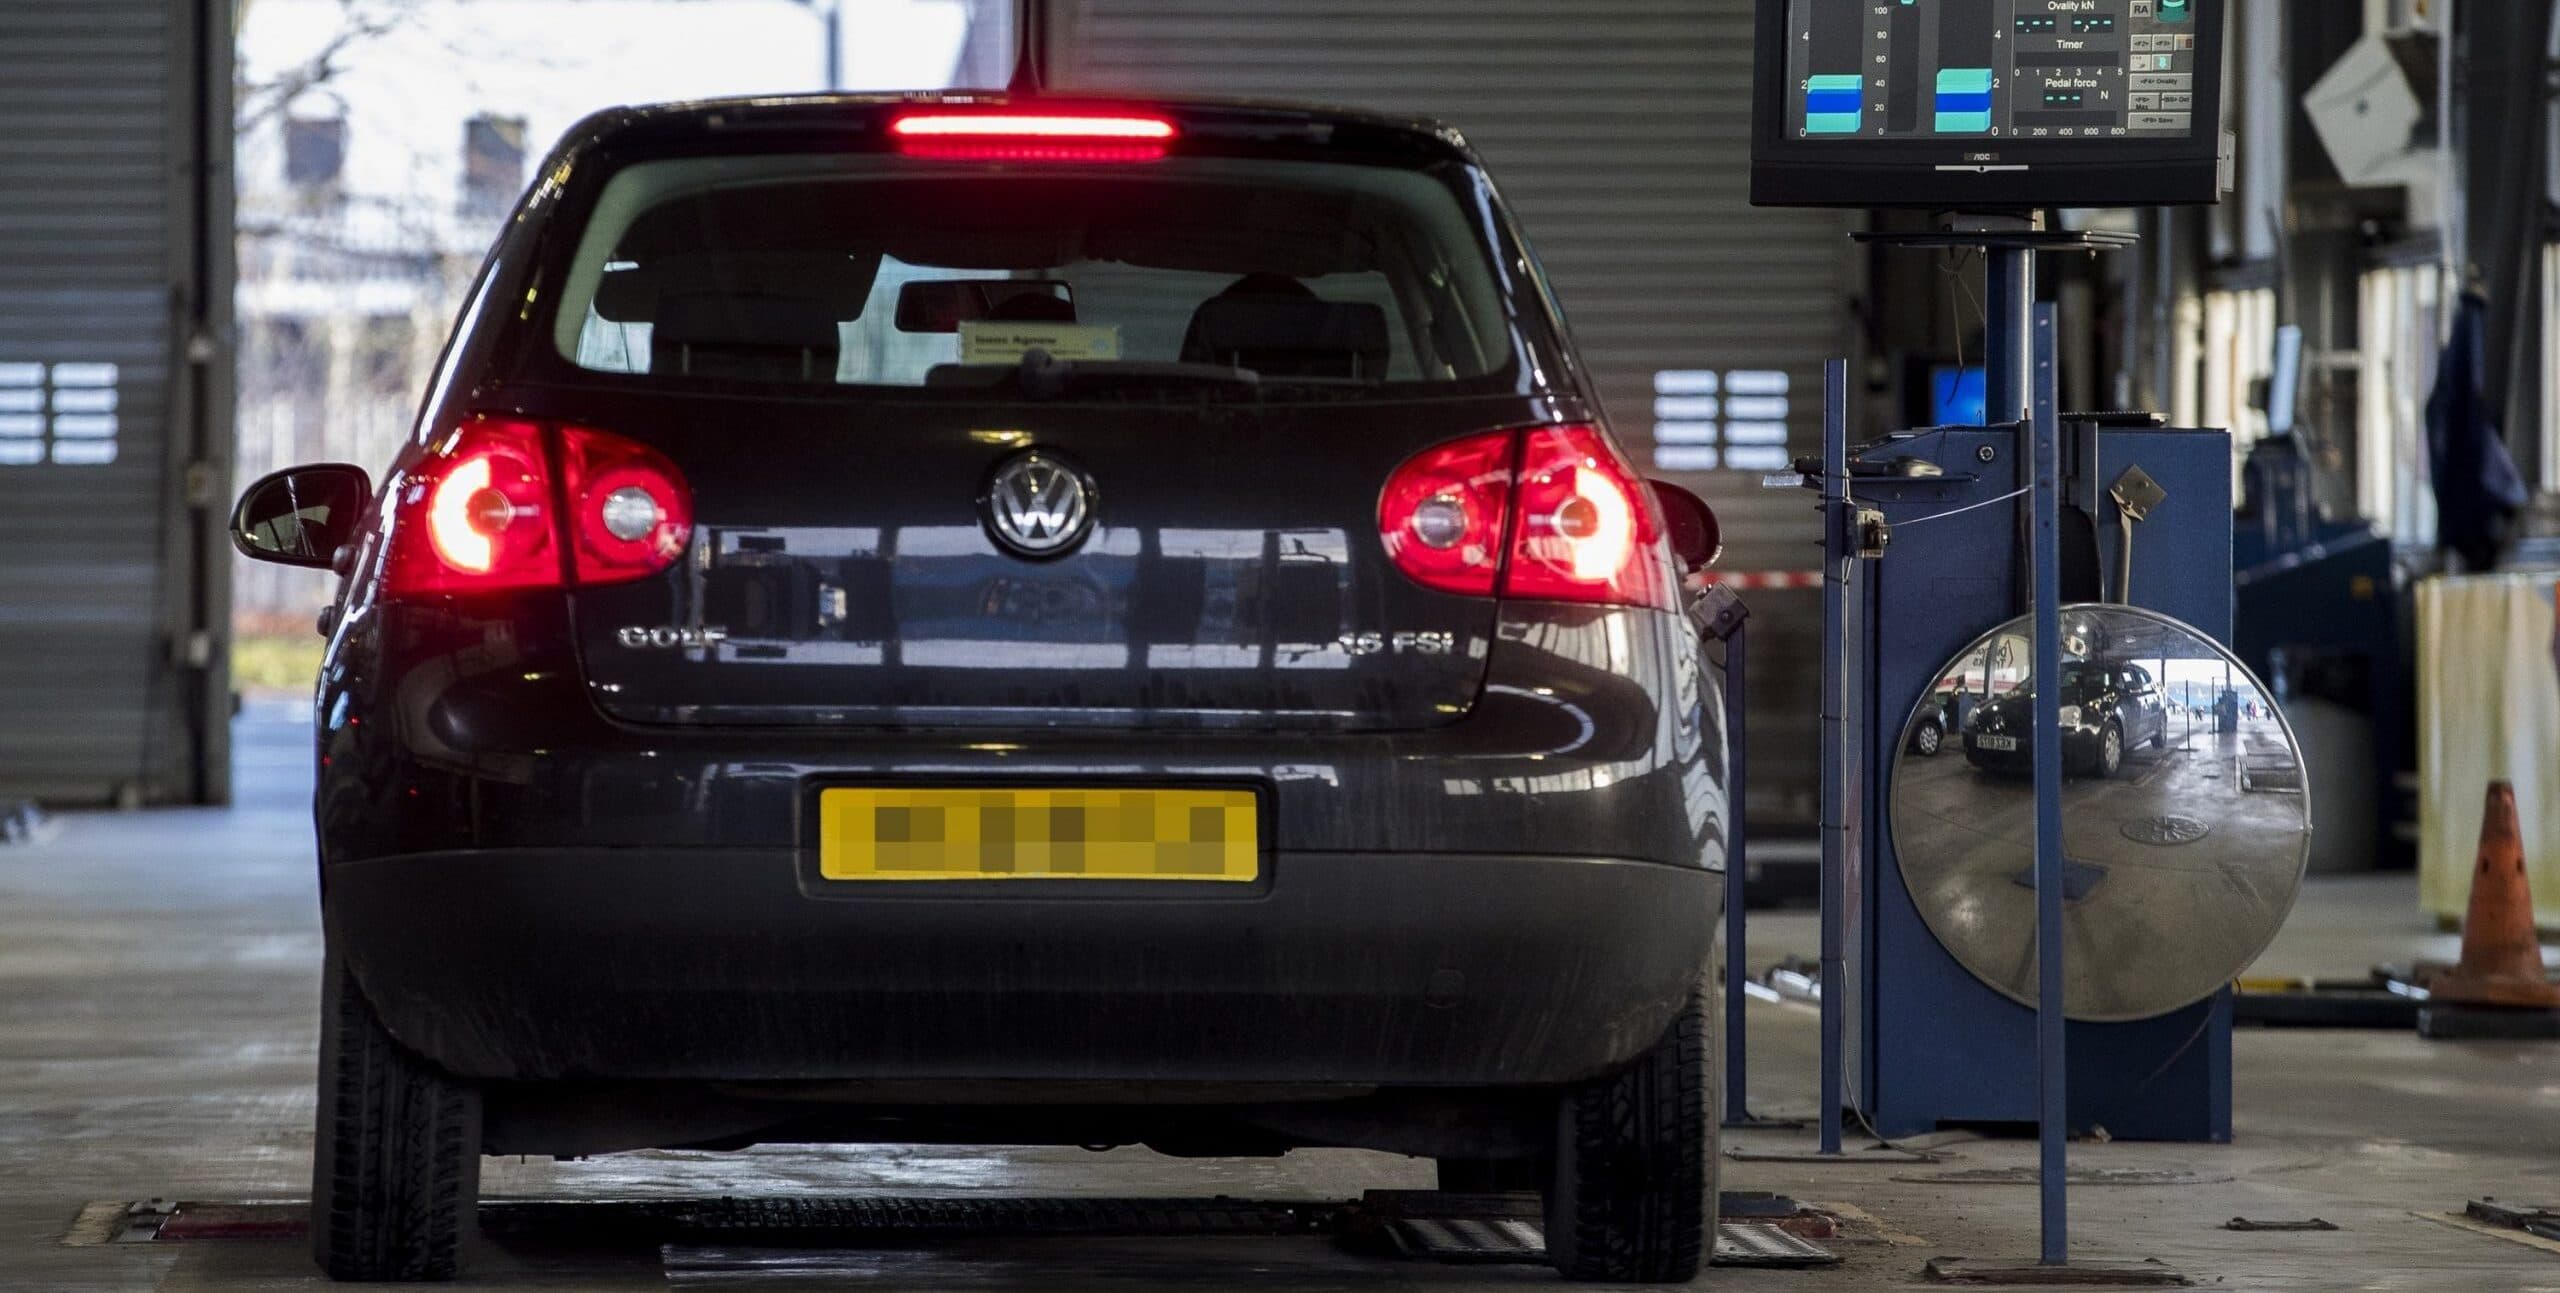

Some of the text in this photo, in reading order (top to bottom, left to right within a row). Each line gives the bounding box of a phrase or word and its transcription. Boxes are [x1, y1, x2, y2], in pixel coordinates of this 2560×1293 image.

[1874, 6, 1888, 15] 100
[2047, 0, 2095, 12] Ovality kN
[2134, 5, 2149, 14] RA
[1802, 31, 1809, 40] 4
[1877, 31, 1887, 39] 80
[1994, 30, 2001, 39] 4
[2056, 39, 2084, 49] Timer
[1876, 55, 1886, 63] 60
[2014, 69, 2020, 77] 0
[2056, 68, 2061, 76] 2
[2076, 68, 2081, 76] 3
[2096, 68, 2102, 76] 4
[2117, 67, 2123, 76] 5
[1801, 80, 1808, 90] 2
[1875, 79, 1886, 88] 40
[1992, 78, 2000, 88] 2
[2045, 78, 2098, 88] Pedal force
[2100, 90, 2109, 100] N
[1874, 104, 1885, 112] 20
[1800, 128, 1807, 138] 0
[1878, 127, 1884, 136] 0
[1991, 127, 1999, 137] 0
[2012, 128, 2018, 136] 0
[2032, 127, 2048, 136] 200
[2058, 127, 2073, 136] 400
[2084, 127, 2099, 136] 600
[1973, 153, 1991, 161] AOC
[618, 626, 727, 648] GOLF
